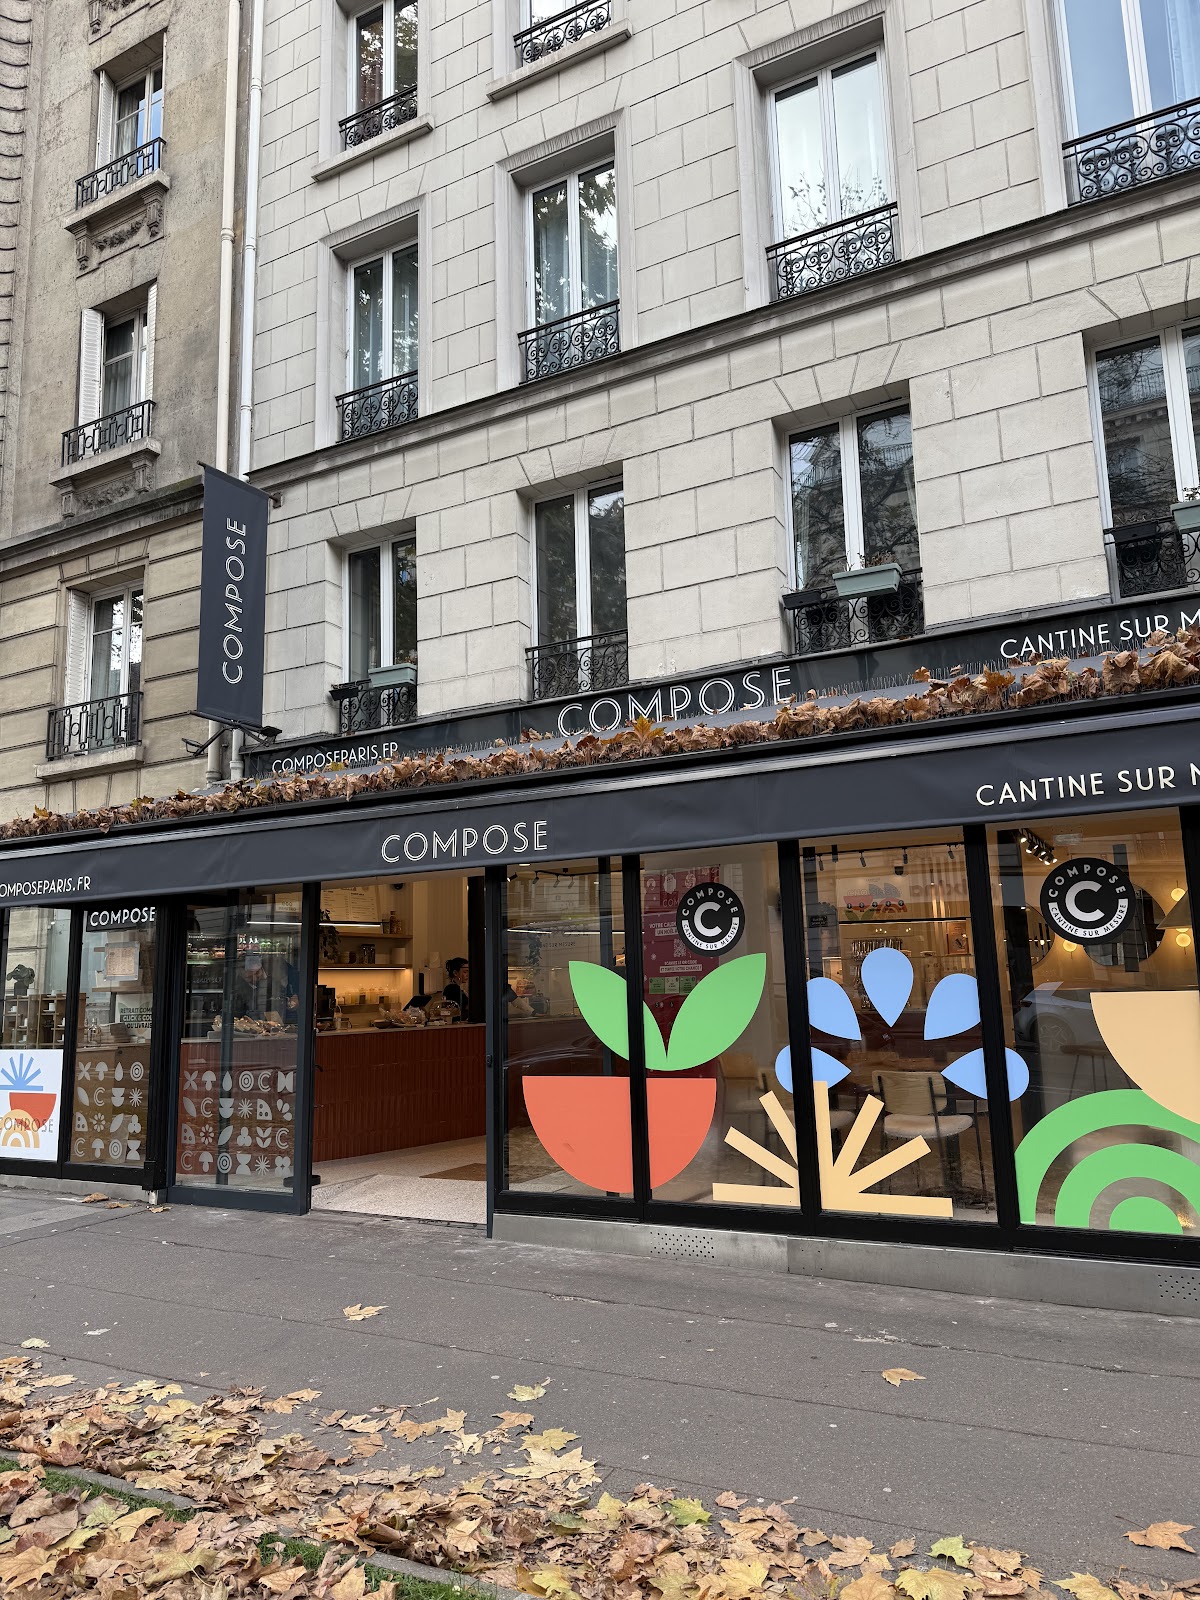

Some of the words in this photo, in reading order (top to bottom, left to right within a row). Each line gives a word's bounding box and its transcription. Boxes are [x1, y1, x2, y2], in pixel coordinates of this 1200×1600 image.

[222, 518, 246, 684] COMPOSE
[1000, 623, 1110, 658] CANTINE
[1120, 614, 1171, 641] SUR
[557, 665, 791, 738] COMPOSE
[976, 772, 1105, 806] CANTINE
[1117, 766, 1176, 793] SUR
[381, 820, 548, 863] COMPOSE
[1048, 864, 1127, 898] COMPOSE
[90, 906, 156, 927] COMPOSE
[682, 887, 739, 916] COMPOSE
[694, 901, 723, 937] C
[1051, 907, 1079, 935] CANTINE
[1103, 904, 1127, 933] MESURE
[1065, 880, 1105, 922] C
[683, 923, 703, 948] CANTINE
[720, 922, 738, 946] MESURE
